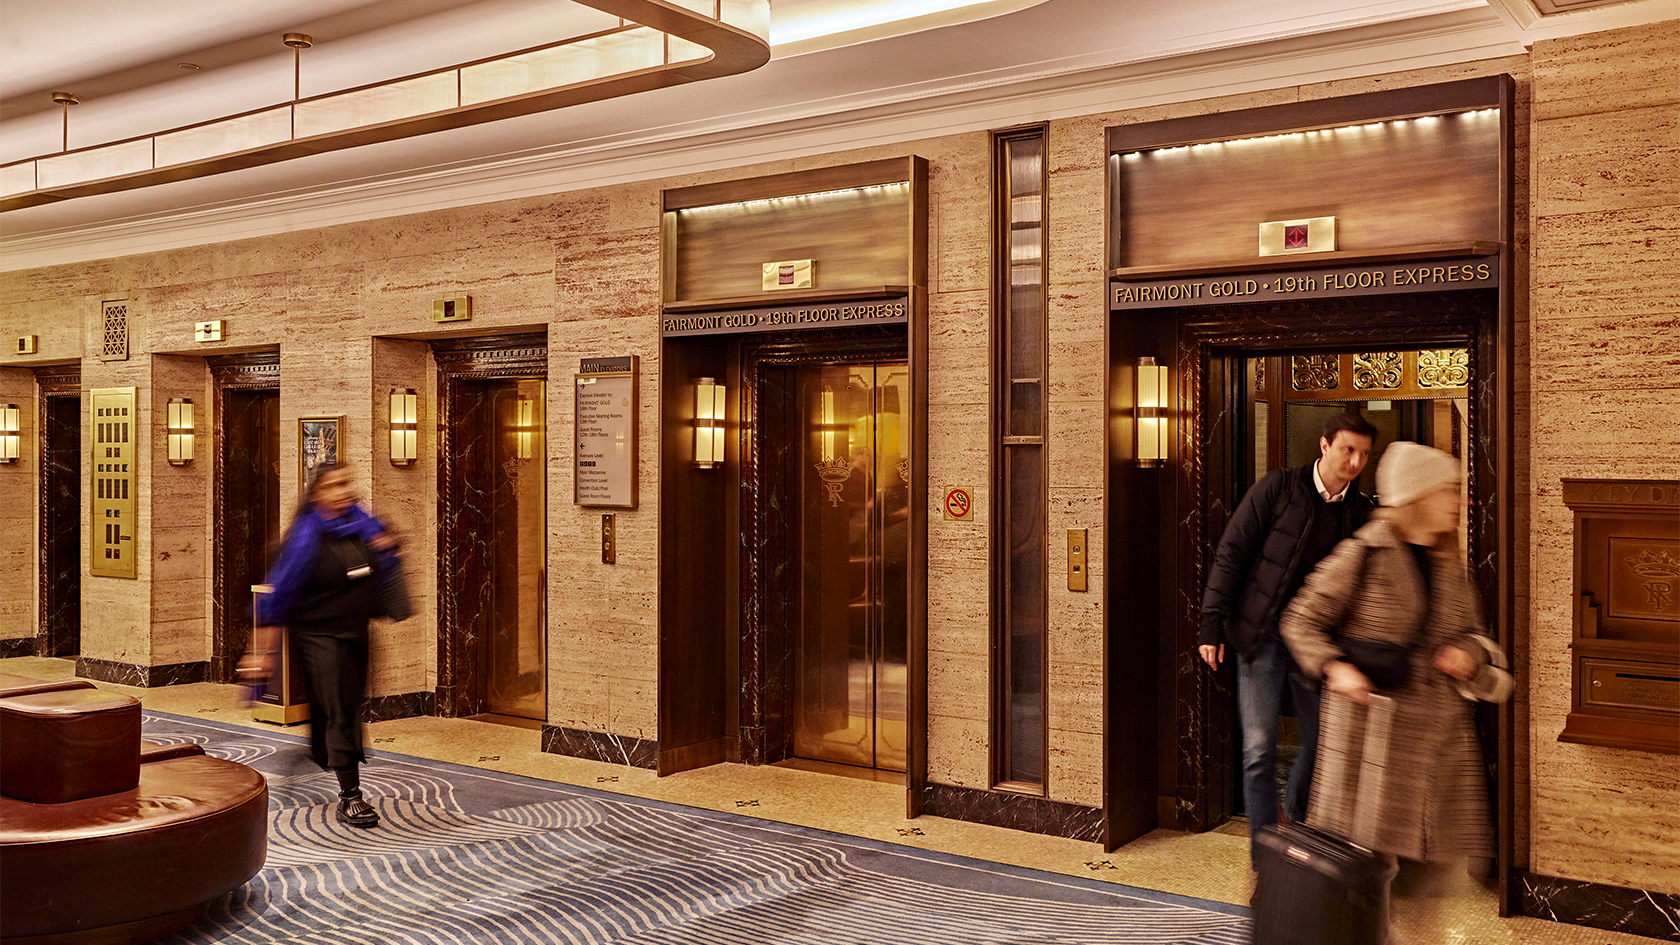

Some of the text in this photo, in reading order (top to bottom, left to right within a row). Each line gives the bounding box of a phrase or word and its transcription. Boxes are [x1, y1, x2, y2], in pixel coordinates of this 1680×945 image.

[1115, 263, 1491, 303] FAIRMONT GOLD 19th FLOOR EXPRESS
[663, 303, 904, 332] FAIRMONT GOLD 19th FLOOR EXPRESS
[580, 363, 600, 373] MAIN
[1588, 485, 1641, 503] KEY
